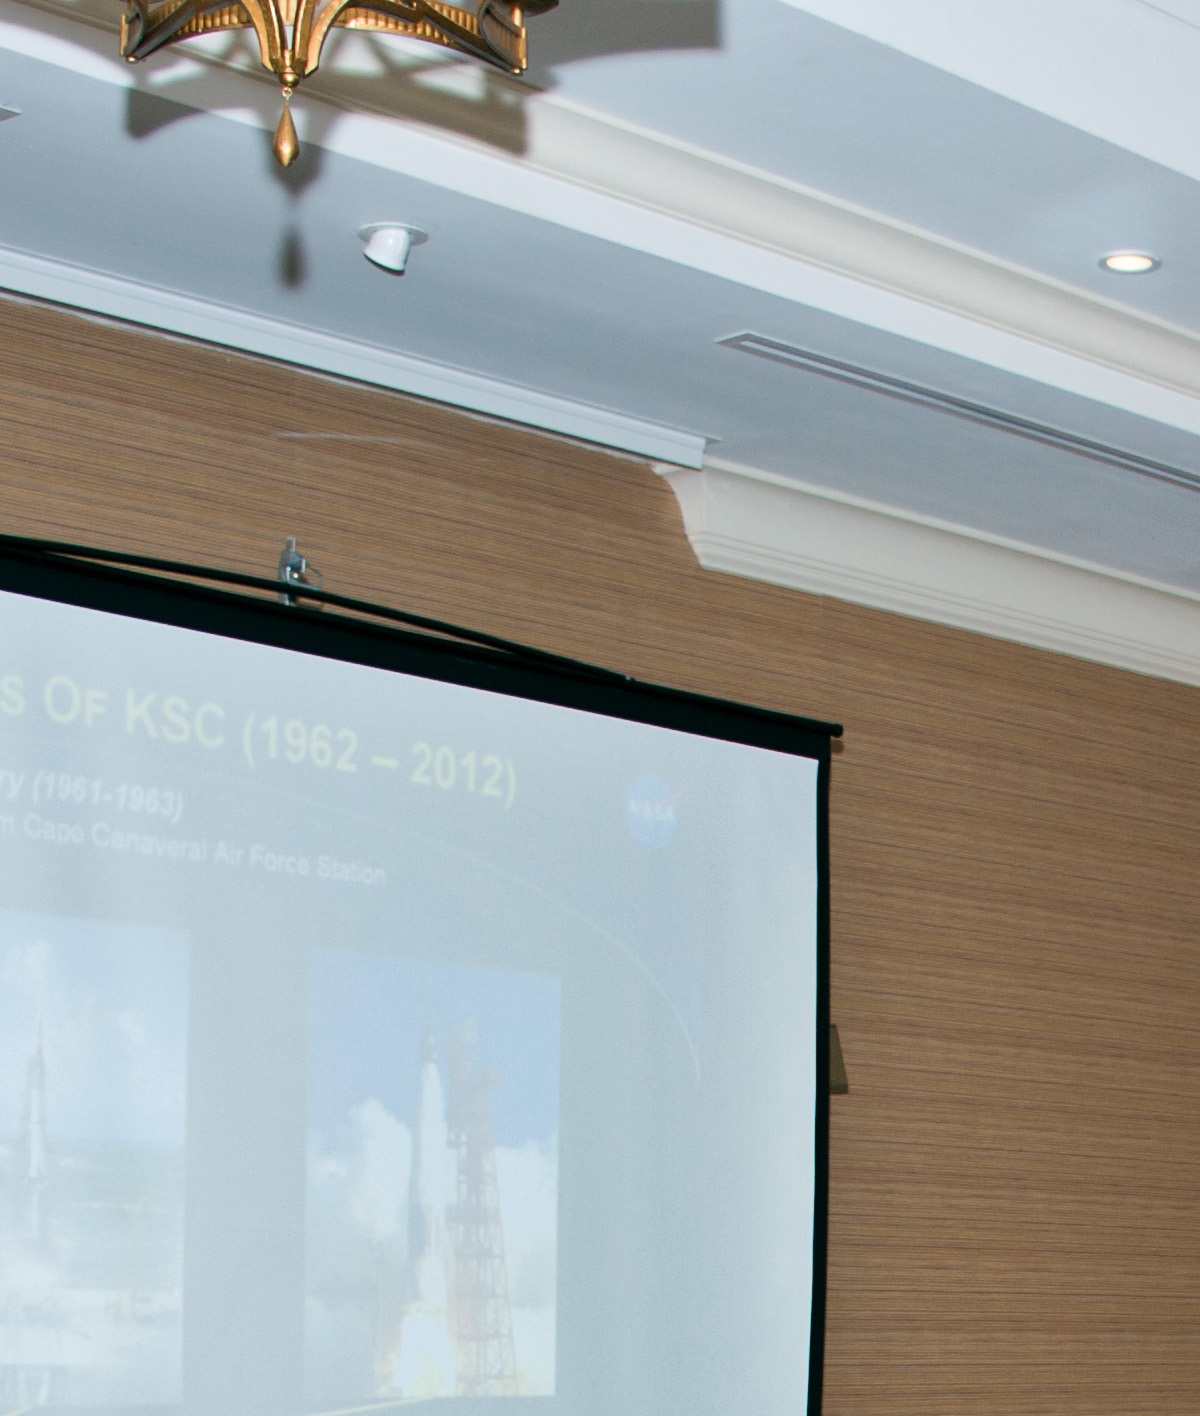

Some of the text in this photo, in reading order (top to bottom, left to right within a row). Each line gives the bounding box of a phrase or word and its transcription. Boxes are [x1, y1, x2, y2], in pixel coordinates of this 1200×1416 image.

[124, 687, 227, 750] KSC
[242, 710, 359, 774] (1962
[409, 740, 518, 810] 2012)
[23, 811, 85, 846] Cape
[92, 817, 208, 861] Canaveral
[213, 838, 244, 865] Air
[249, 842, 310, 876] Force
[316, 853, 386, 885] Station
